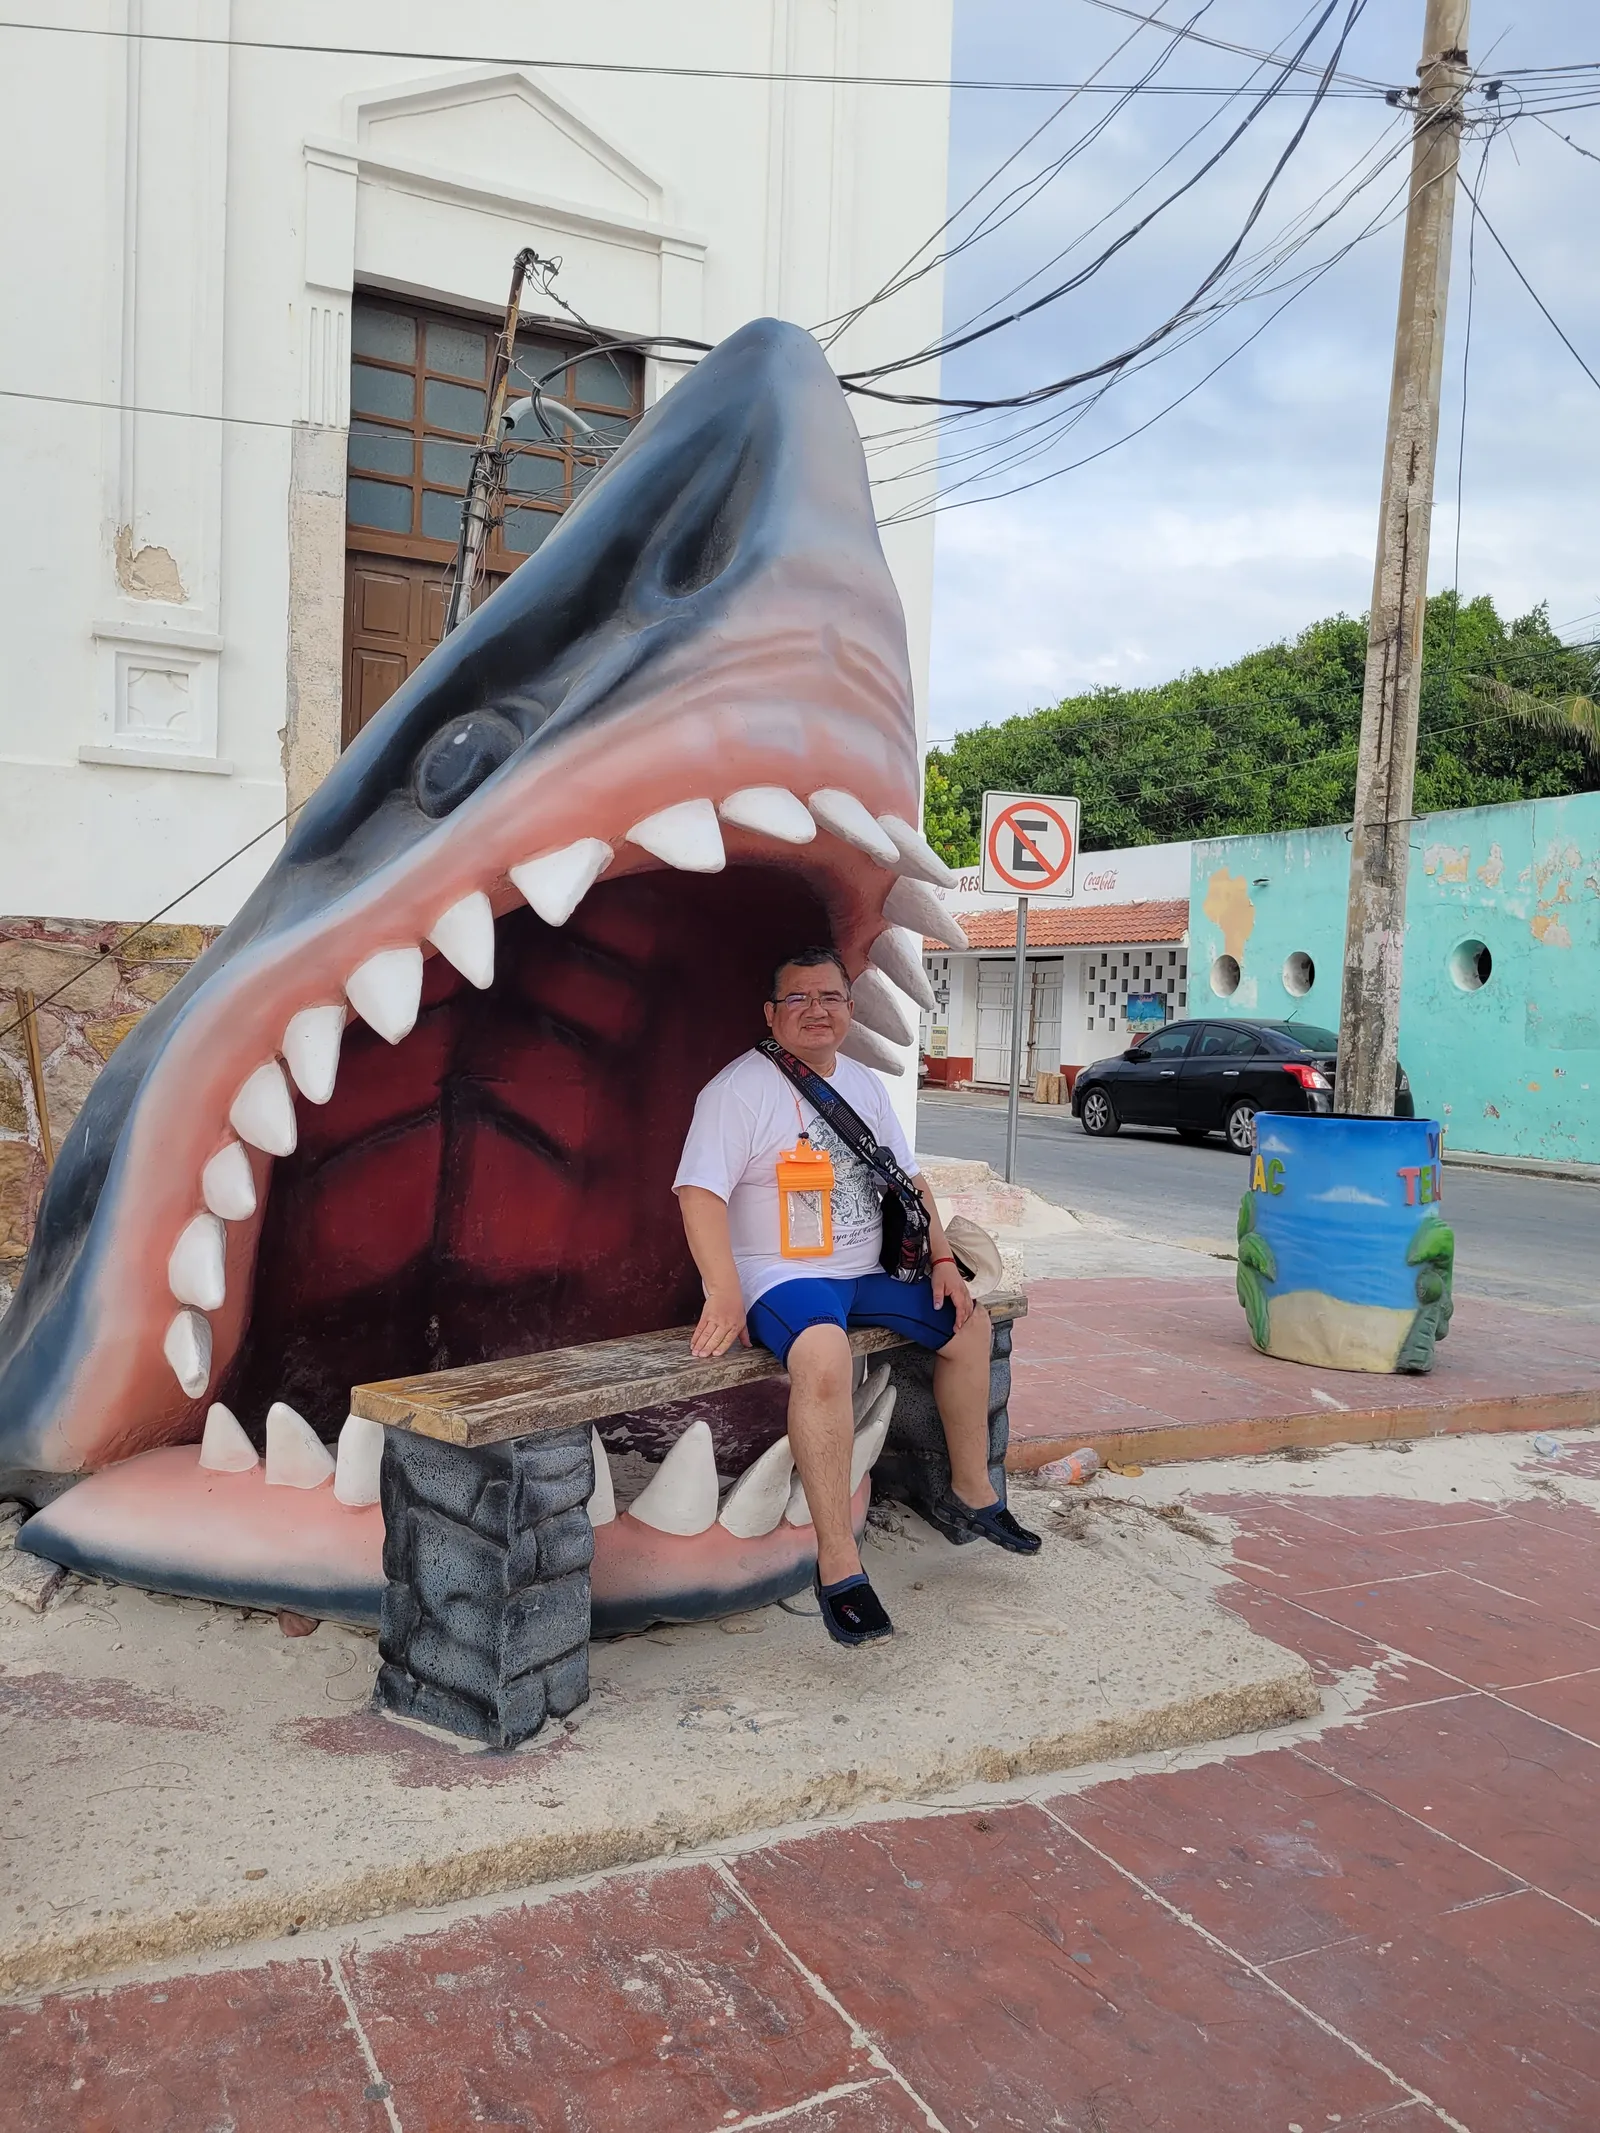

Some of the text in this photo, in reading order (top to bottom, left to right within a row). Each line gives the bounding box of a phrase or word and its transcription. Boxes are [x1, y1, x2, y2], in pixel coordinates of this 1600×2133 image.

[1012, 819, 1048, 872] E
[959, 875, 980, 893] RES
[1428, 1132, 1443, 1159] VI
[1250, 1154, 1286, 1196] AC
[1396, 1165, 1443, 1206] TEL
